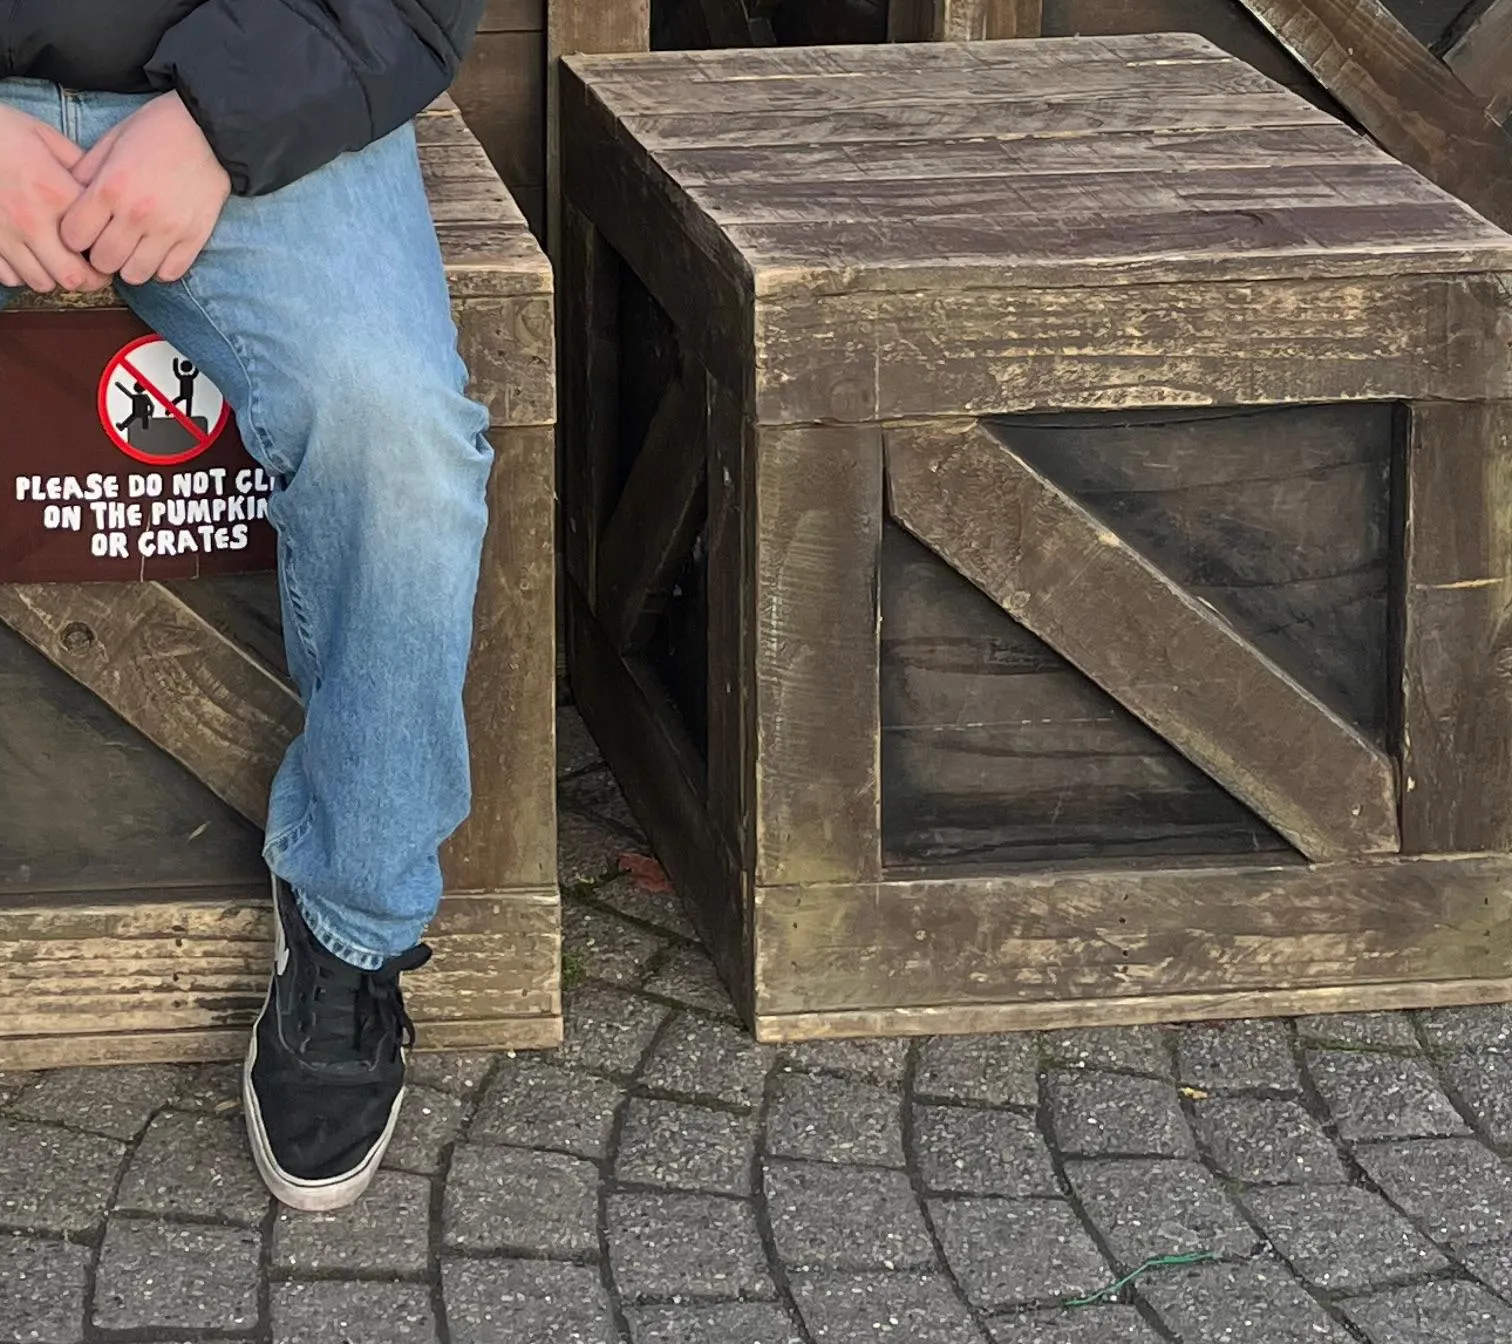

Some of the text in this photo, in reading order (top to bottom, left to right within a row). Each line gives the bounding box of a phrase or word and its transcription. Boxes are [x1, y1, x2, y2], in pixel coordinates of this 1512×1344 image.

[15, 473, 119, 501] PLEASE
[129, 474, 162, 497] DO
[172, 468, 226, 497] NOT
[44, 505, 81, 531] ON
[90, 502, 142, 530] THE
[92, 524, 248, 558] OR CRATES
